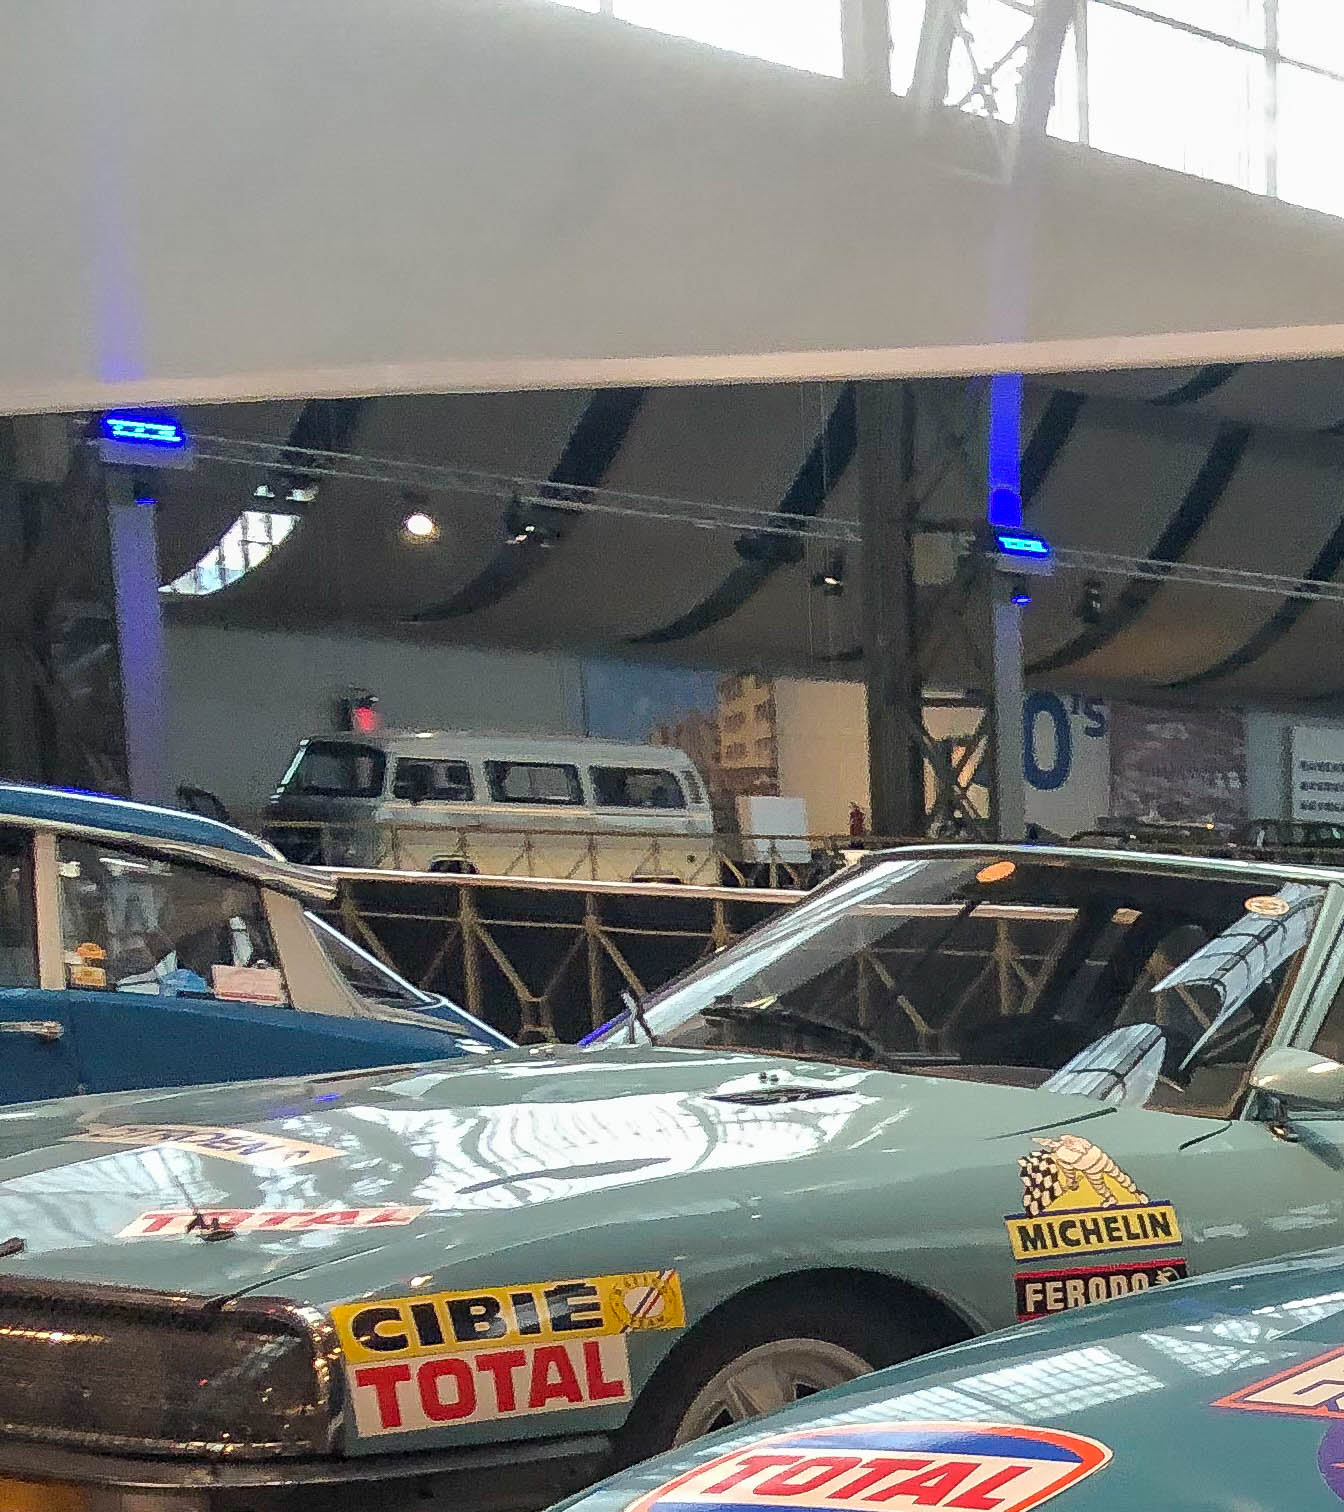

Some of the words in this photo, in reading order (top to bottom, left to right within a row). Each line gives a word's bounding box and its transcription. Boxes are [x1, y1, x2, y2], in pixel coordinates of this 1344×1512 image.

[141, 1207, 416, 1234] TOTAL
[1017, 1211, 1173, 1252] MICHELIN
[356, 1341, 625, 1429] TOTAL
[700, 1455, 1033, 1510] TOTAL
